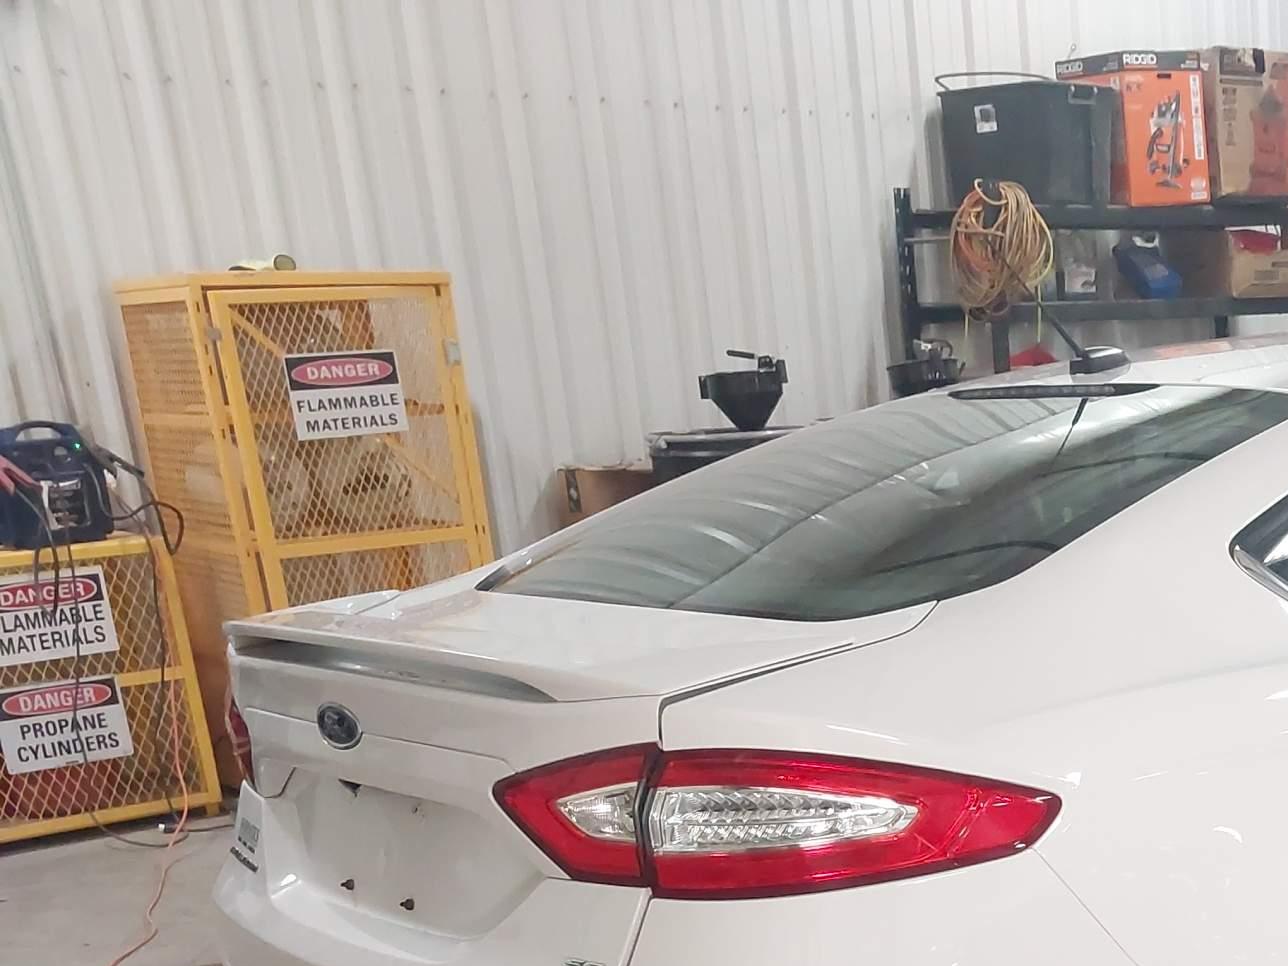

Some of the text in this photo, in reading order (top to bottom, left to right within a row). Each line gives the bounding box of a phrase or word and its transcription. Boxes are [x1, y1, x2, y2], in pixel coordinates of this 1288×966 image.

[1122, 53, 1157, 65] RIDGID
[306, 362, 380, 381] DANGER
[296, 393, 401, 414] FLAMMABLE
[306, 413, 399, 433] MATERIALS
[0, 603, 105, 633] LAMMABLE
[0, 625, 106, 657] MATERIALS
[18, 686, 96, 714] DANGER
[19, 712, 108, 741] PROPANE
[17, 732, 120, 763] CYLINDERS
